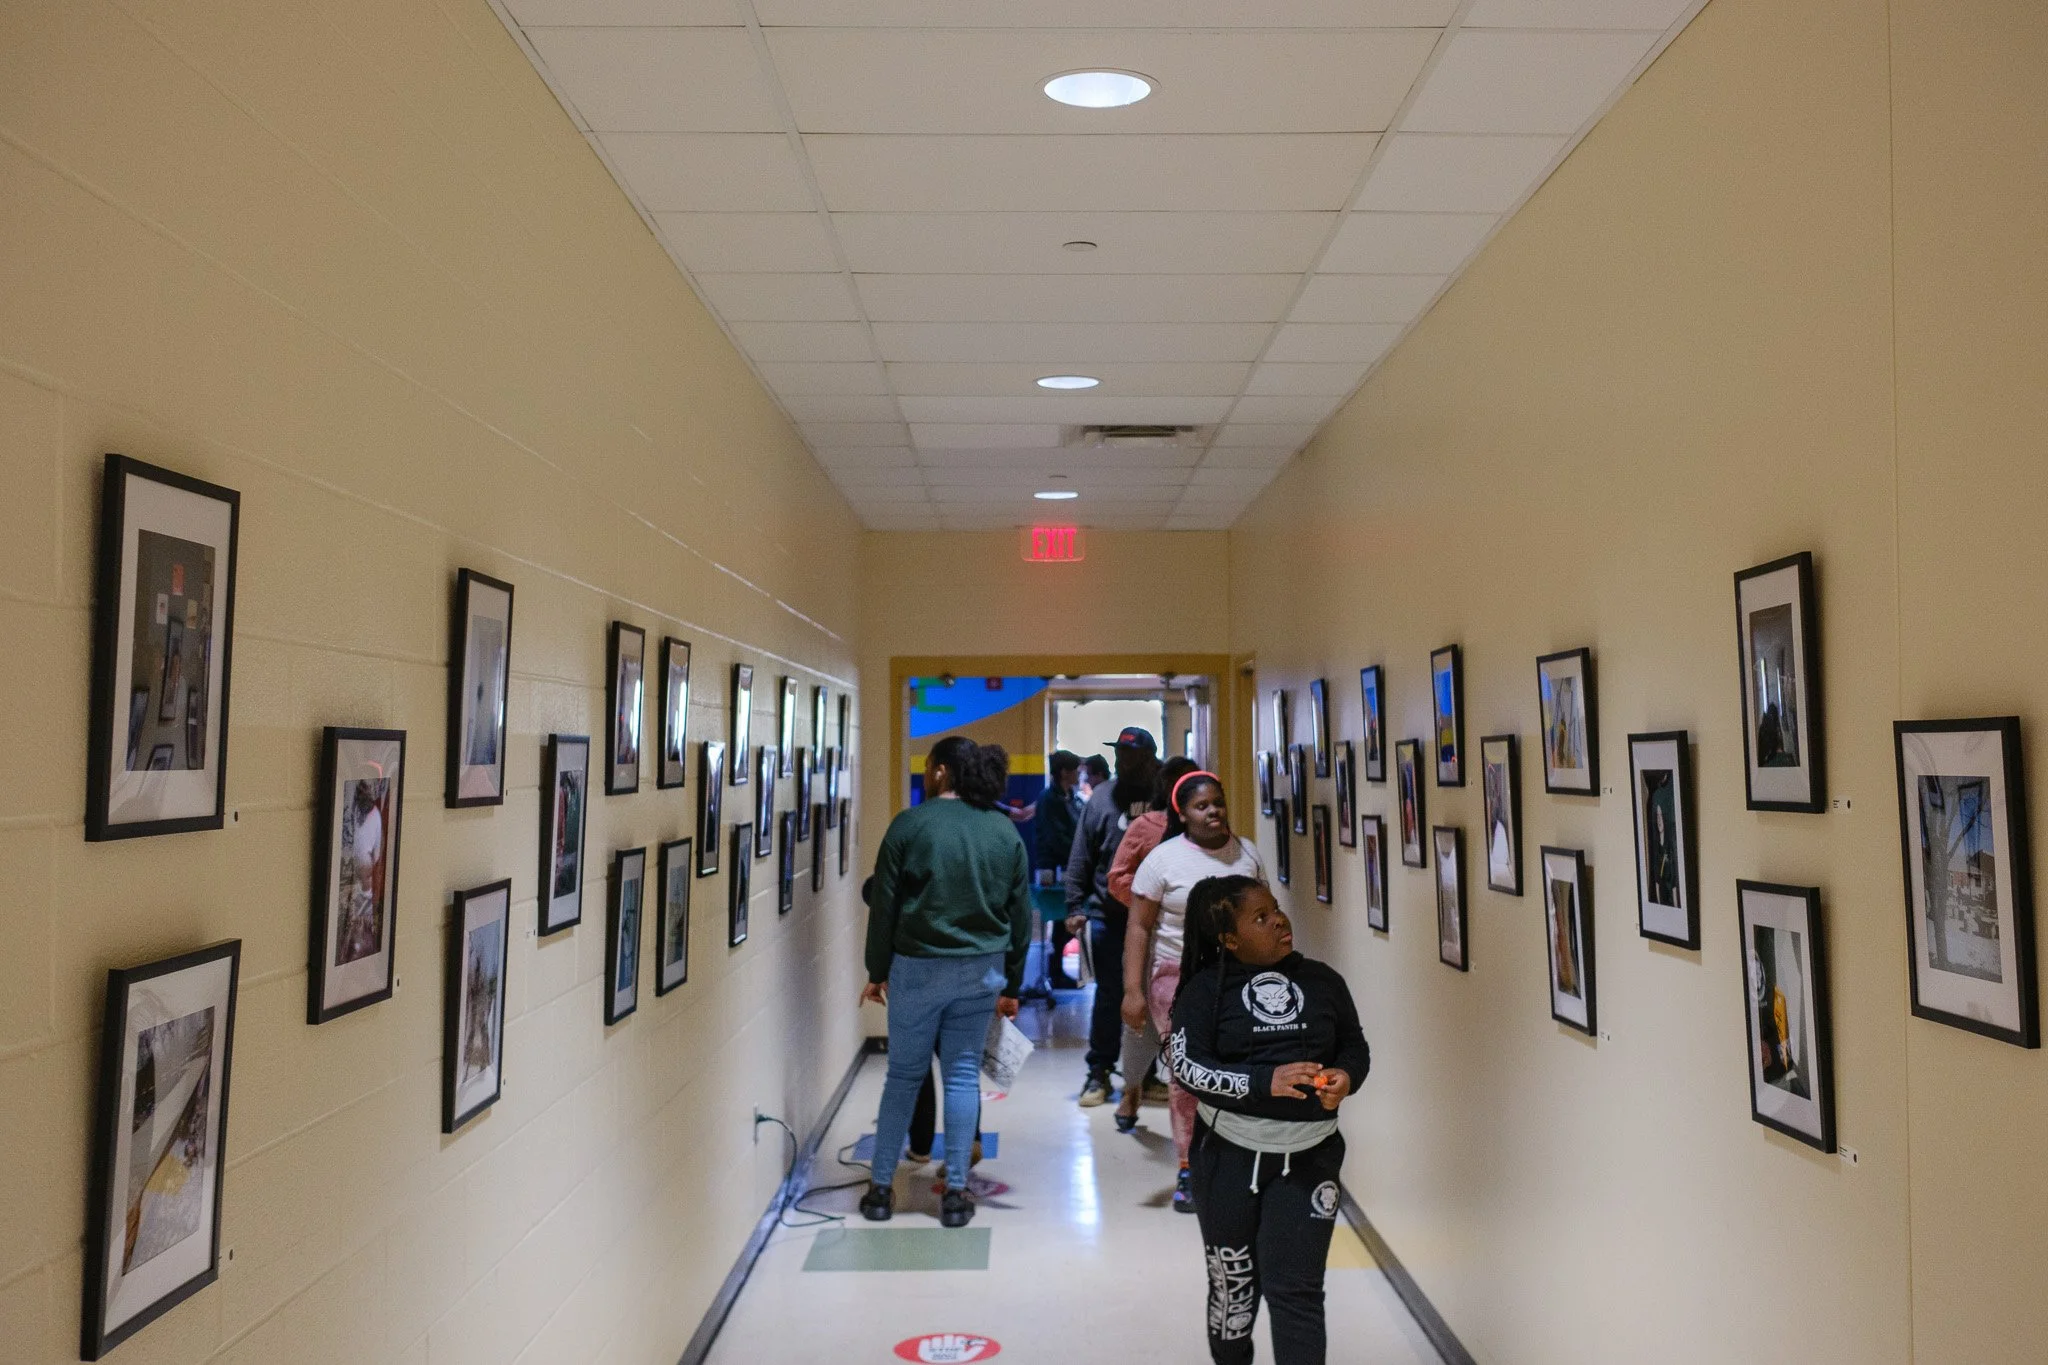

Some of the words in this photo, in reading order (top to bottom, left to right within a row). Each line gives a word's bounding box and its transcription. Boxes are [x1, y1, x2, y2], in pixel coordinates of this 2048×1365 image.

[1032, 527, 1077, 559] EXIT
[1252, 1025, 1277, 1033] BLACK
[1276, 1022, 1308, 1031] PANTHR
[1220, 1245, 1254, 1341] FOREVER
